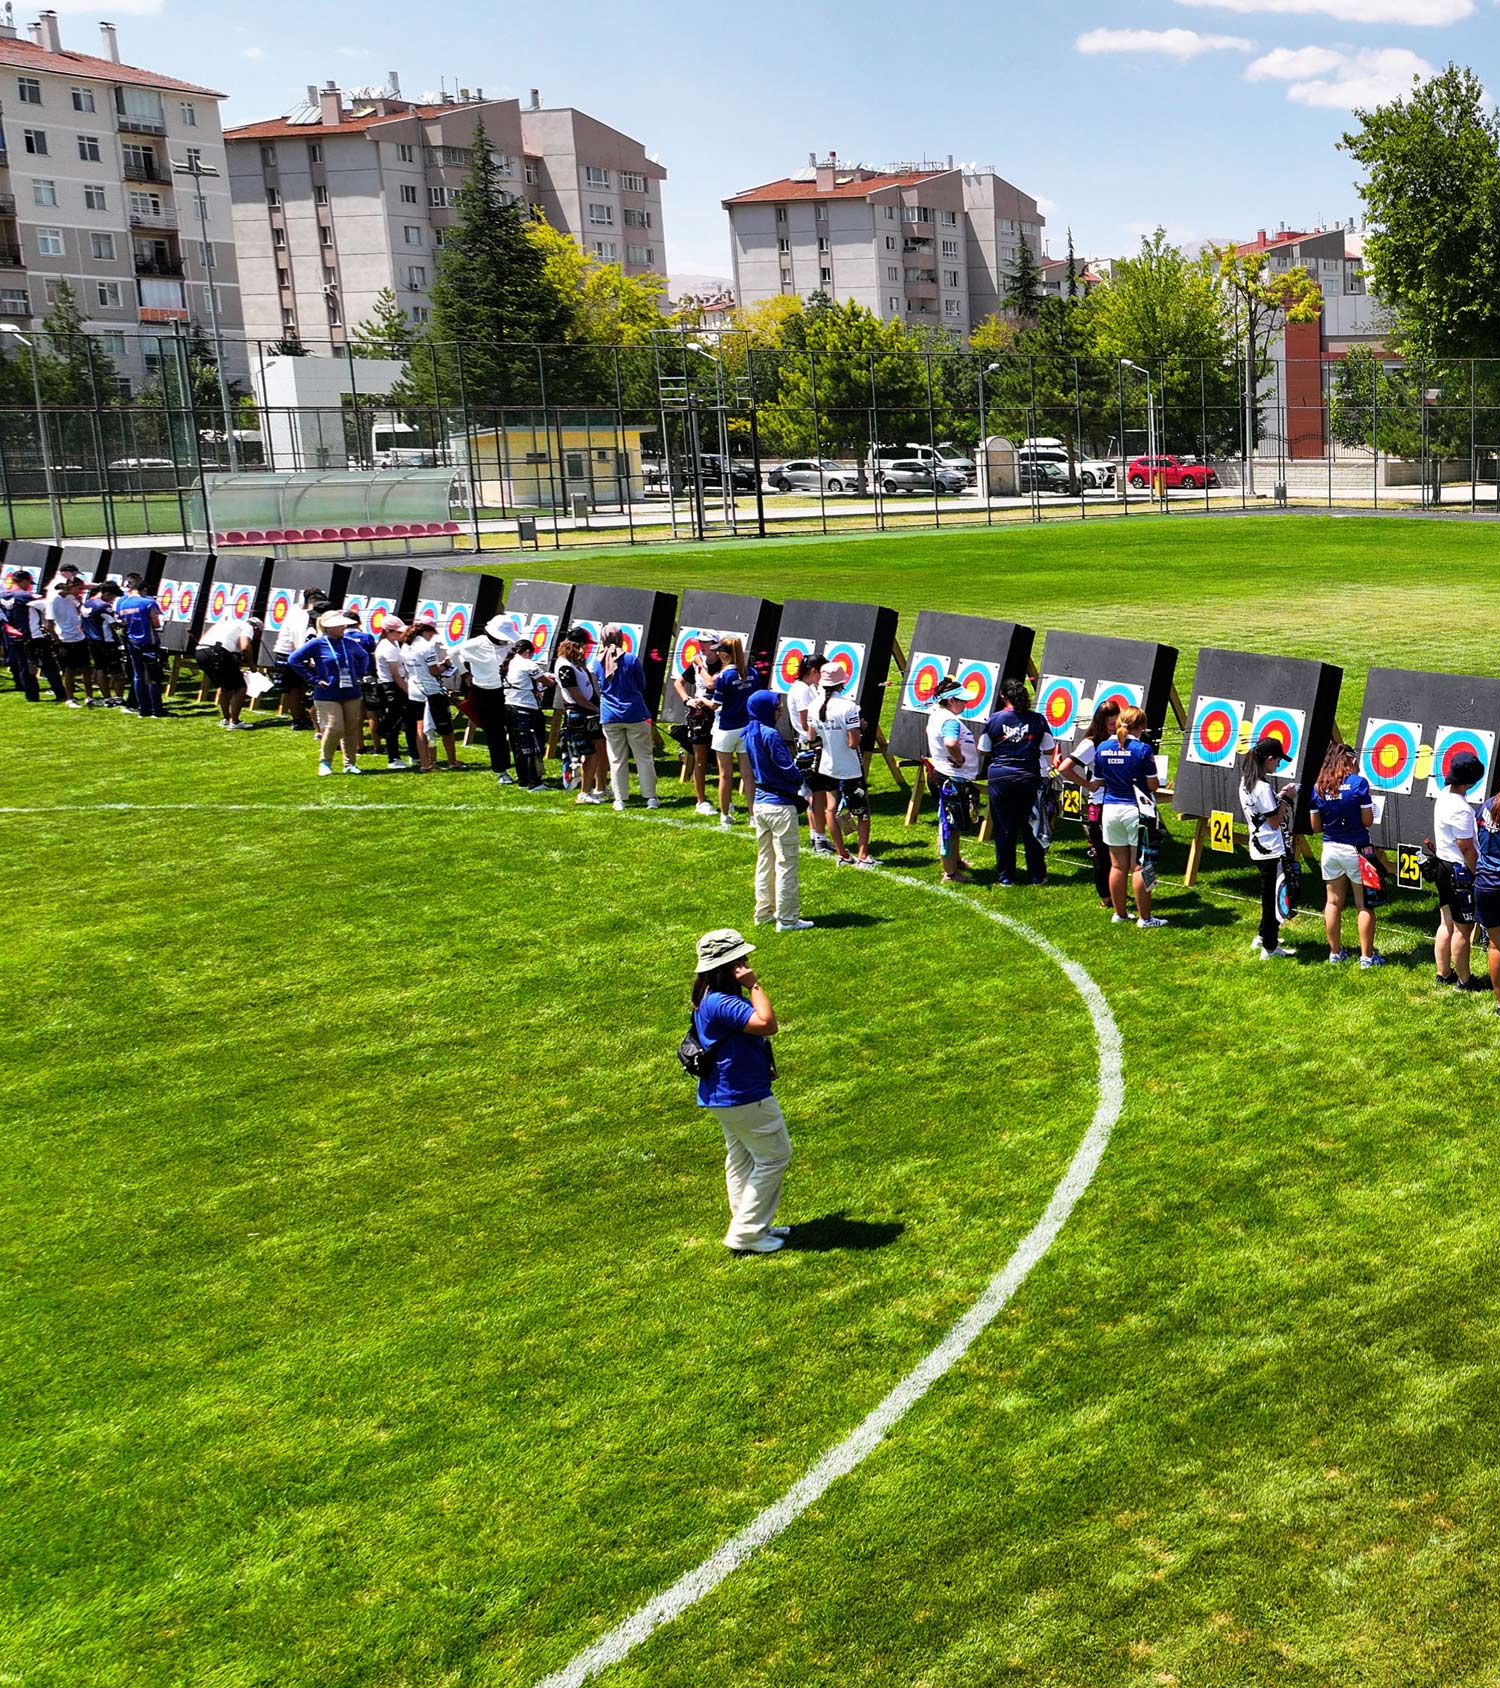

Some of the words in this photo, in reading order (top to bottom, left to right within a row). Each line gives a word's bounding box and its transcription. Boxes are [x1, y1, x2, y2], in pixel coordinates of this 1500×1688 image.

[1064, 789, 1080, 814] 23
[1214, 820, 1231, 844] 24
[1400, 853, 1420, 881] 25
